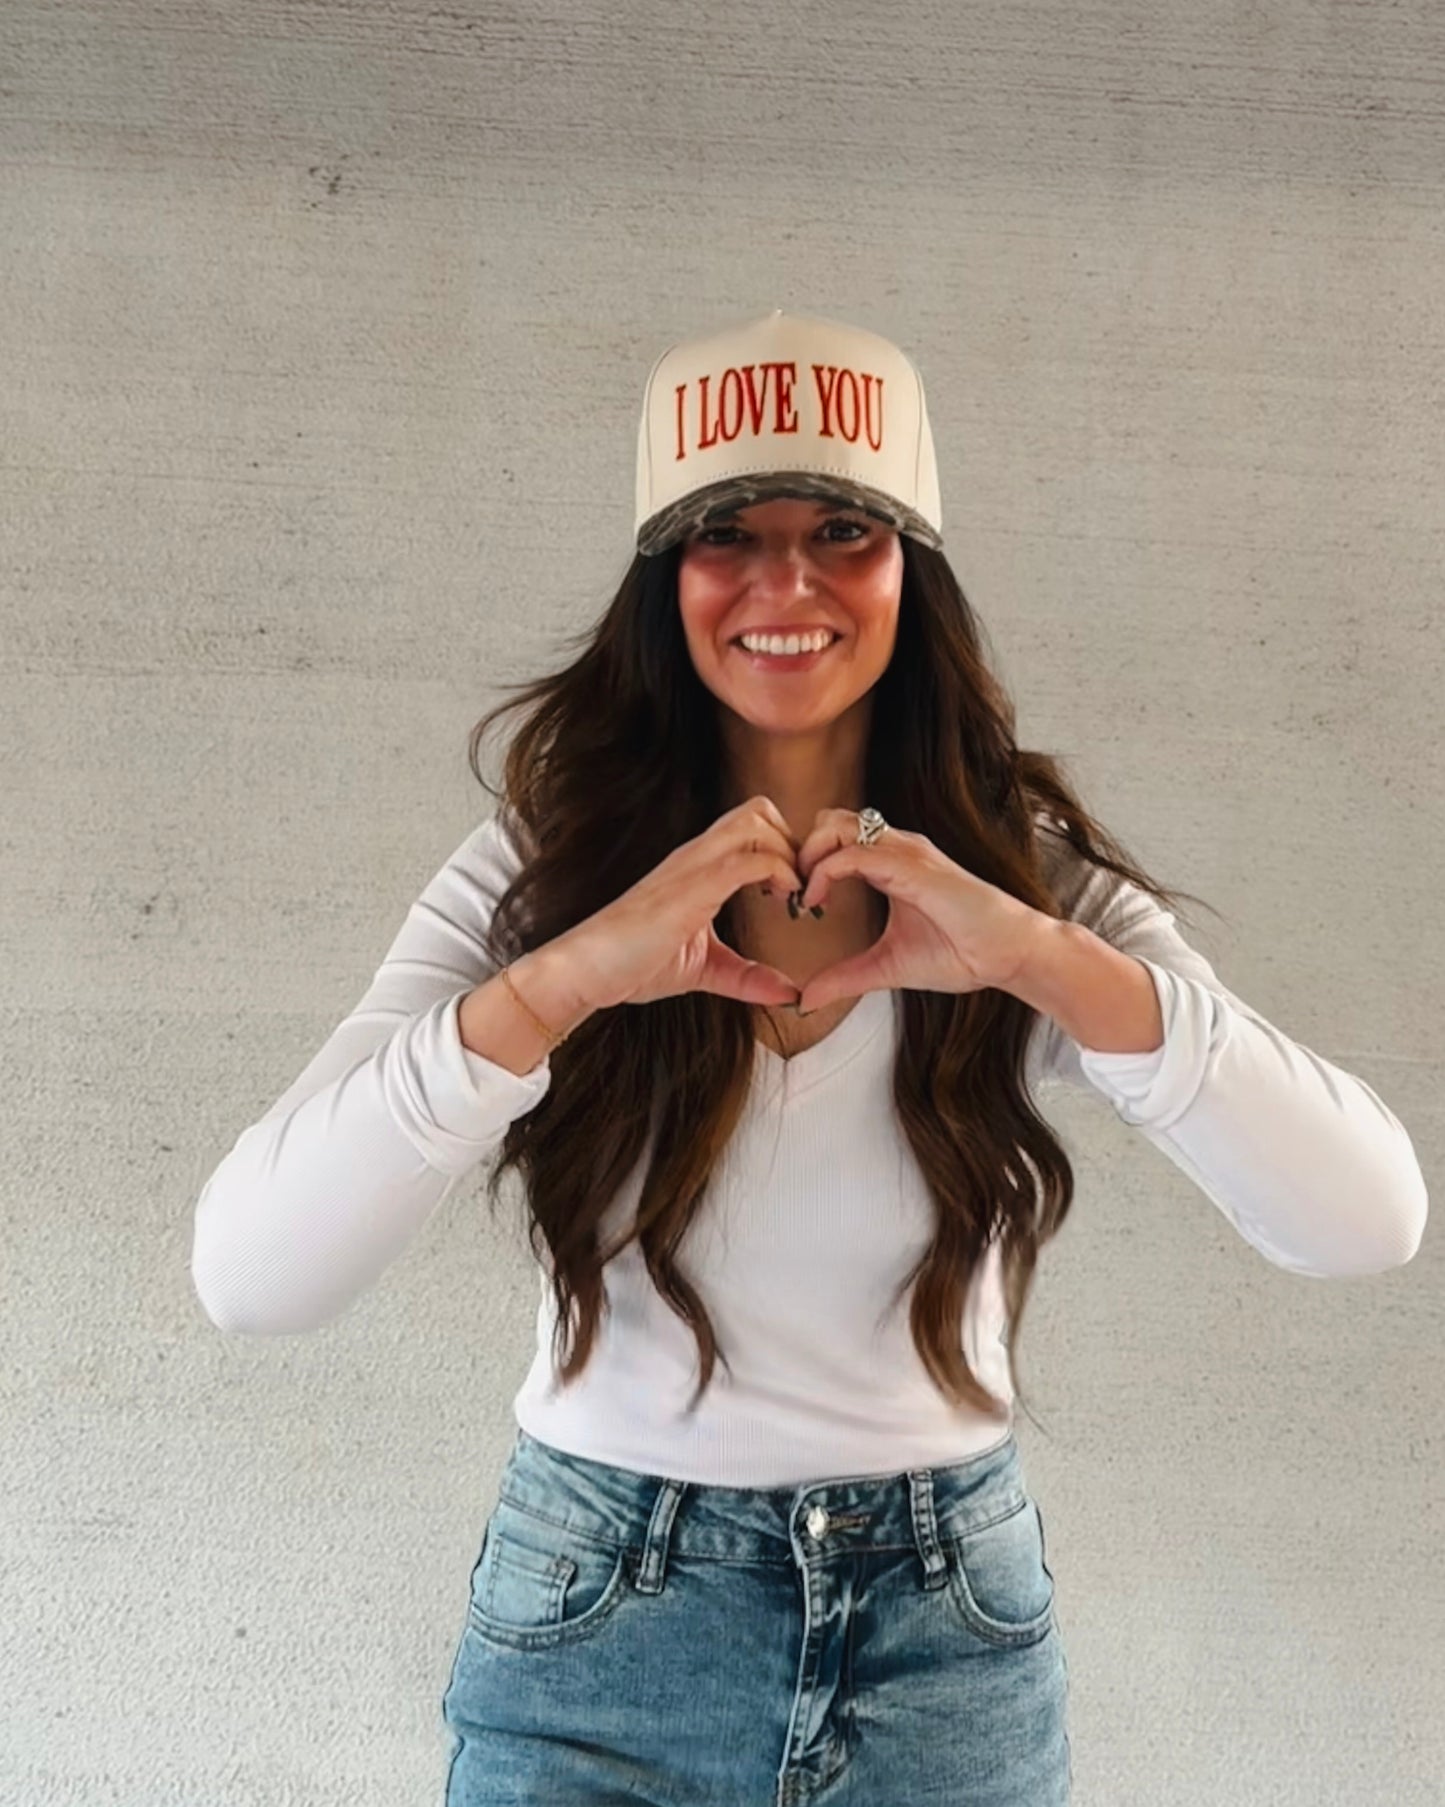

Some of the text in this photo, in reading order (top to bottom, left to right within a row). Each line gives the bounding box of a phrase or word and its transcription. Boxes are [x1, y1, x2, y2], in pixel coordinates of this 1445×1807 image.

[675, 362, 884, 461] I LOVE YOU
